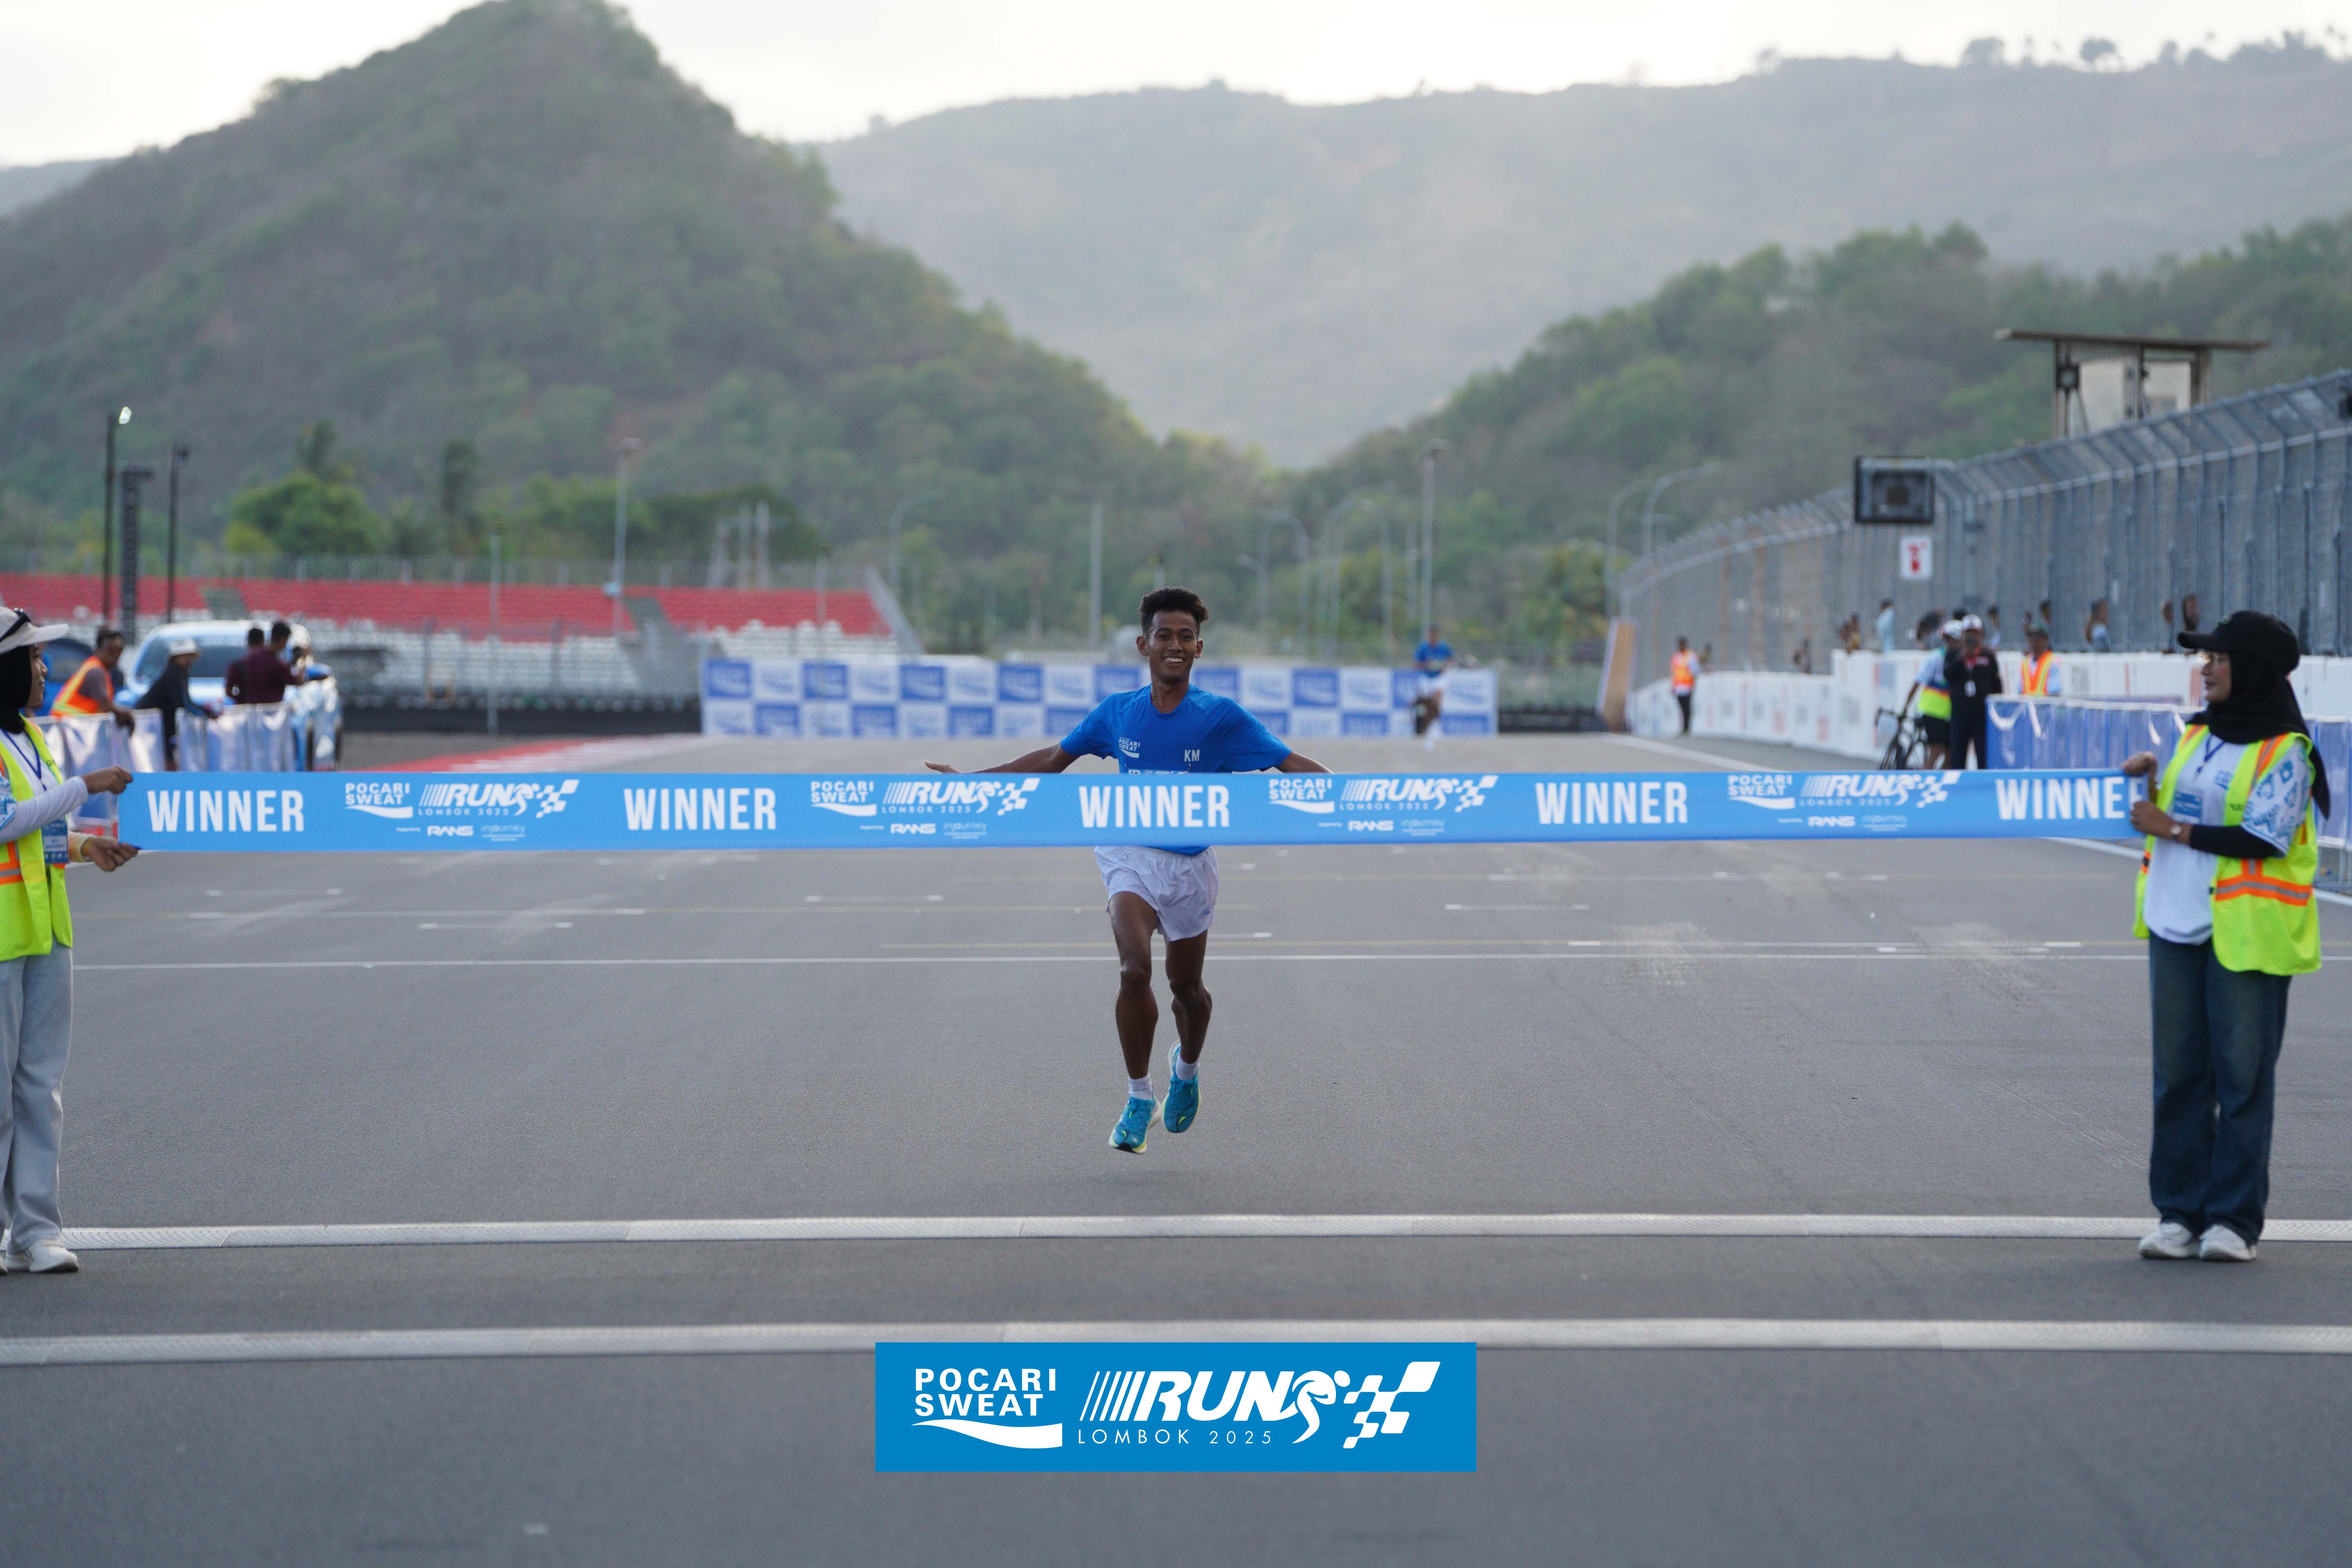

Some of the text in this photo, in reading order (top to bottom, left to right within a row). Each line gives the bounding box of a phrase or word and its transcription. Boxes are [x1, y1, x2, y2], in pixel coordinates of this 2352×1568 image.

[1119, 739, 1140, 747] POCARI
[1119, 743, 1137, 751] SWEAT
[1184, 749, 1200, 762] KM
[1269, 779, 1332, 789] POCARI
[1728, 775, 1792, 785] POCARI
[345, 783, 410, 794] POCARI
[811, 781, 874, 792] POCARI
[1728, 784, 1786, 796] SWEAT
[345, 794, 404, 805] SWEAT
[811, 791, 868, 803] SWEAT
[1269, 788, 1327, 800] SWEAT
[1078, 785, 1230, 828] WINNER
[1535, 782, 1688, 824] WINNER
[147, 790, 304, 832] WINNER
[623, 788, 776, 830] WINNER
[1348, 820, 1394, 831] RANS
[1808, 816, 1856, 827] RANS
[427, 826, 474, 836] RANS
[890, 823, 936, 834] RANS
